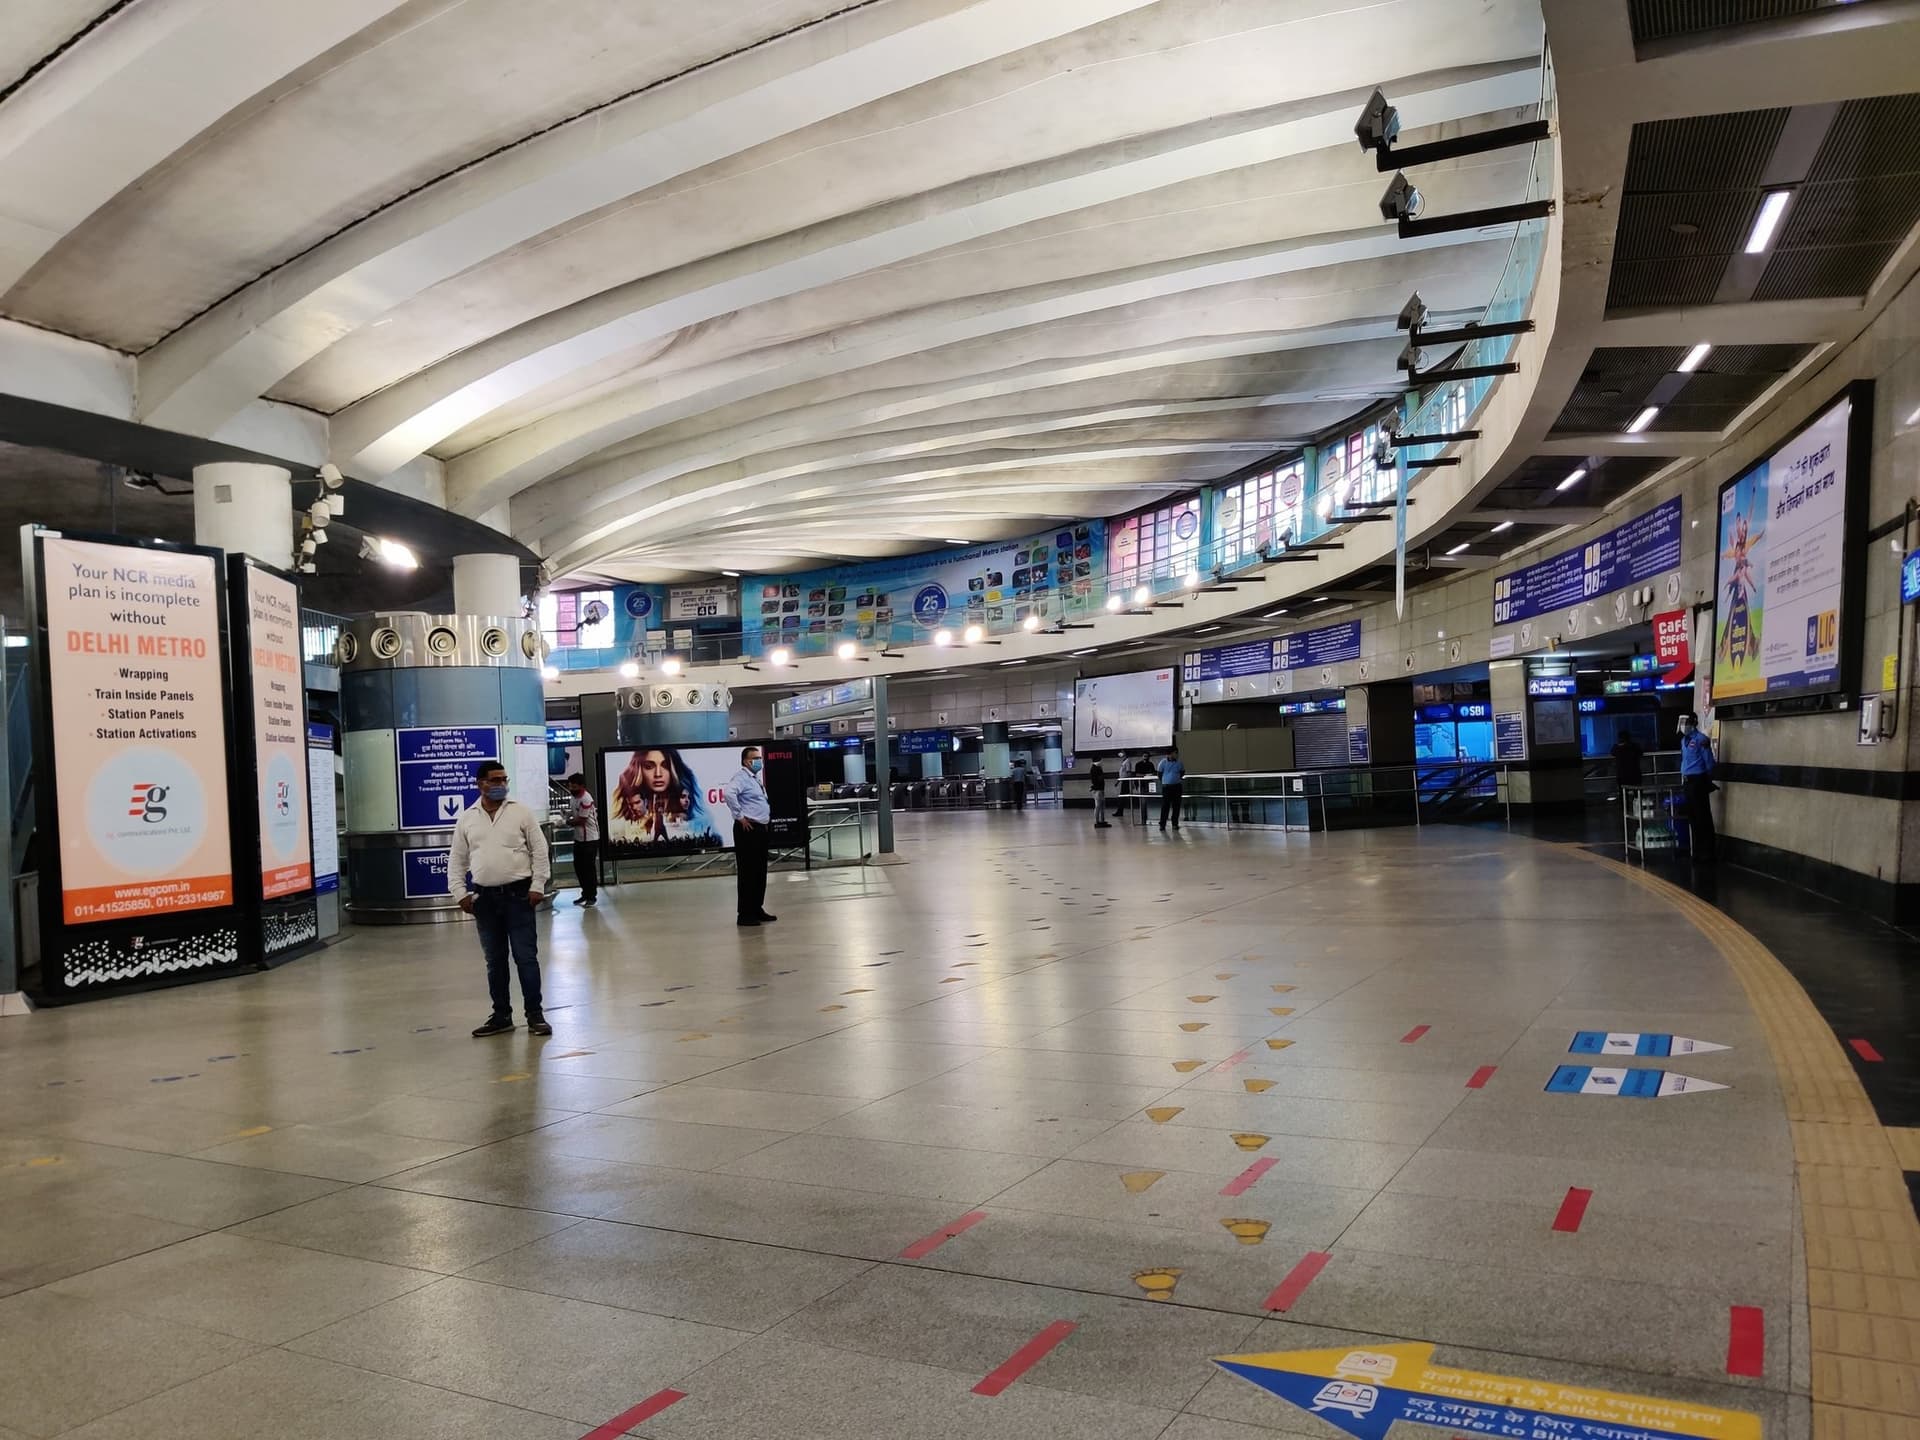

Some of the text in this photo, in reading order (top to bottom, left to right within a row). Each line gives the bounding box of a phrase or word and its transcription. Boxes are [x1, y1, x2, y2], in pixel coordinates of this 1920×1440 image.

[982, 548, 999, 557] Metro
[72, 563, 196, 588] Your NCR media
[69, 584, 200, 608] plan is incomplete
[632, 597, 646, 609] 25
[922, 594, 938, 611] 25
[110, 610, 166, 626] without
[1658, 614, 1688, 634] Café
[1660, 632, 1688, 646] Coffe
[1819, 614, 1835, 648] LIC
[67, 630, 207, 659] DELHI METRO
[1661, 646, 1678, 656] Day
[275, 652, 296, 674] METRO
[119, 668, 169, 682] Wrapping
[95, 688, 194, 702] Train Inside Panels
[108, 708, 184, 720] Station Panels
[1469, 705, 1484, 716] SBI
[1582, 700, 1596, 712] SBI
[96, 728, 198, 739] Station Activations
[454, 750, 466, 758] City
[768, 752, 792, 760] NETFLIX
[114, 881, 190, 898] www.egcom.in
[1470, 1378, 1523, 1393] लाइन
[1530, 1383, 1549, 1397] के
[1558, 1388, 1600, 1407] लिए
[1418, 1381, 1676, 1430] Transfer to Yellow Line
[1408, 1397, 1437, 1412] ब्लू
[1441, 1403, 1499, 1420] लाइन
[1504, 1410, 1526, 1424] के
[1534, 1415, 1576, 1434] लिए
[1403, 1408, 1582, 1440] Transfer to Blu
